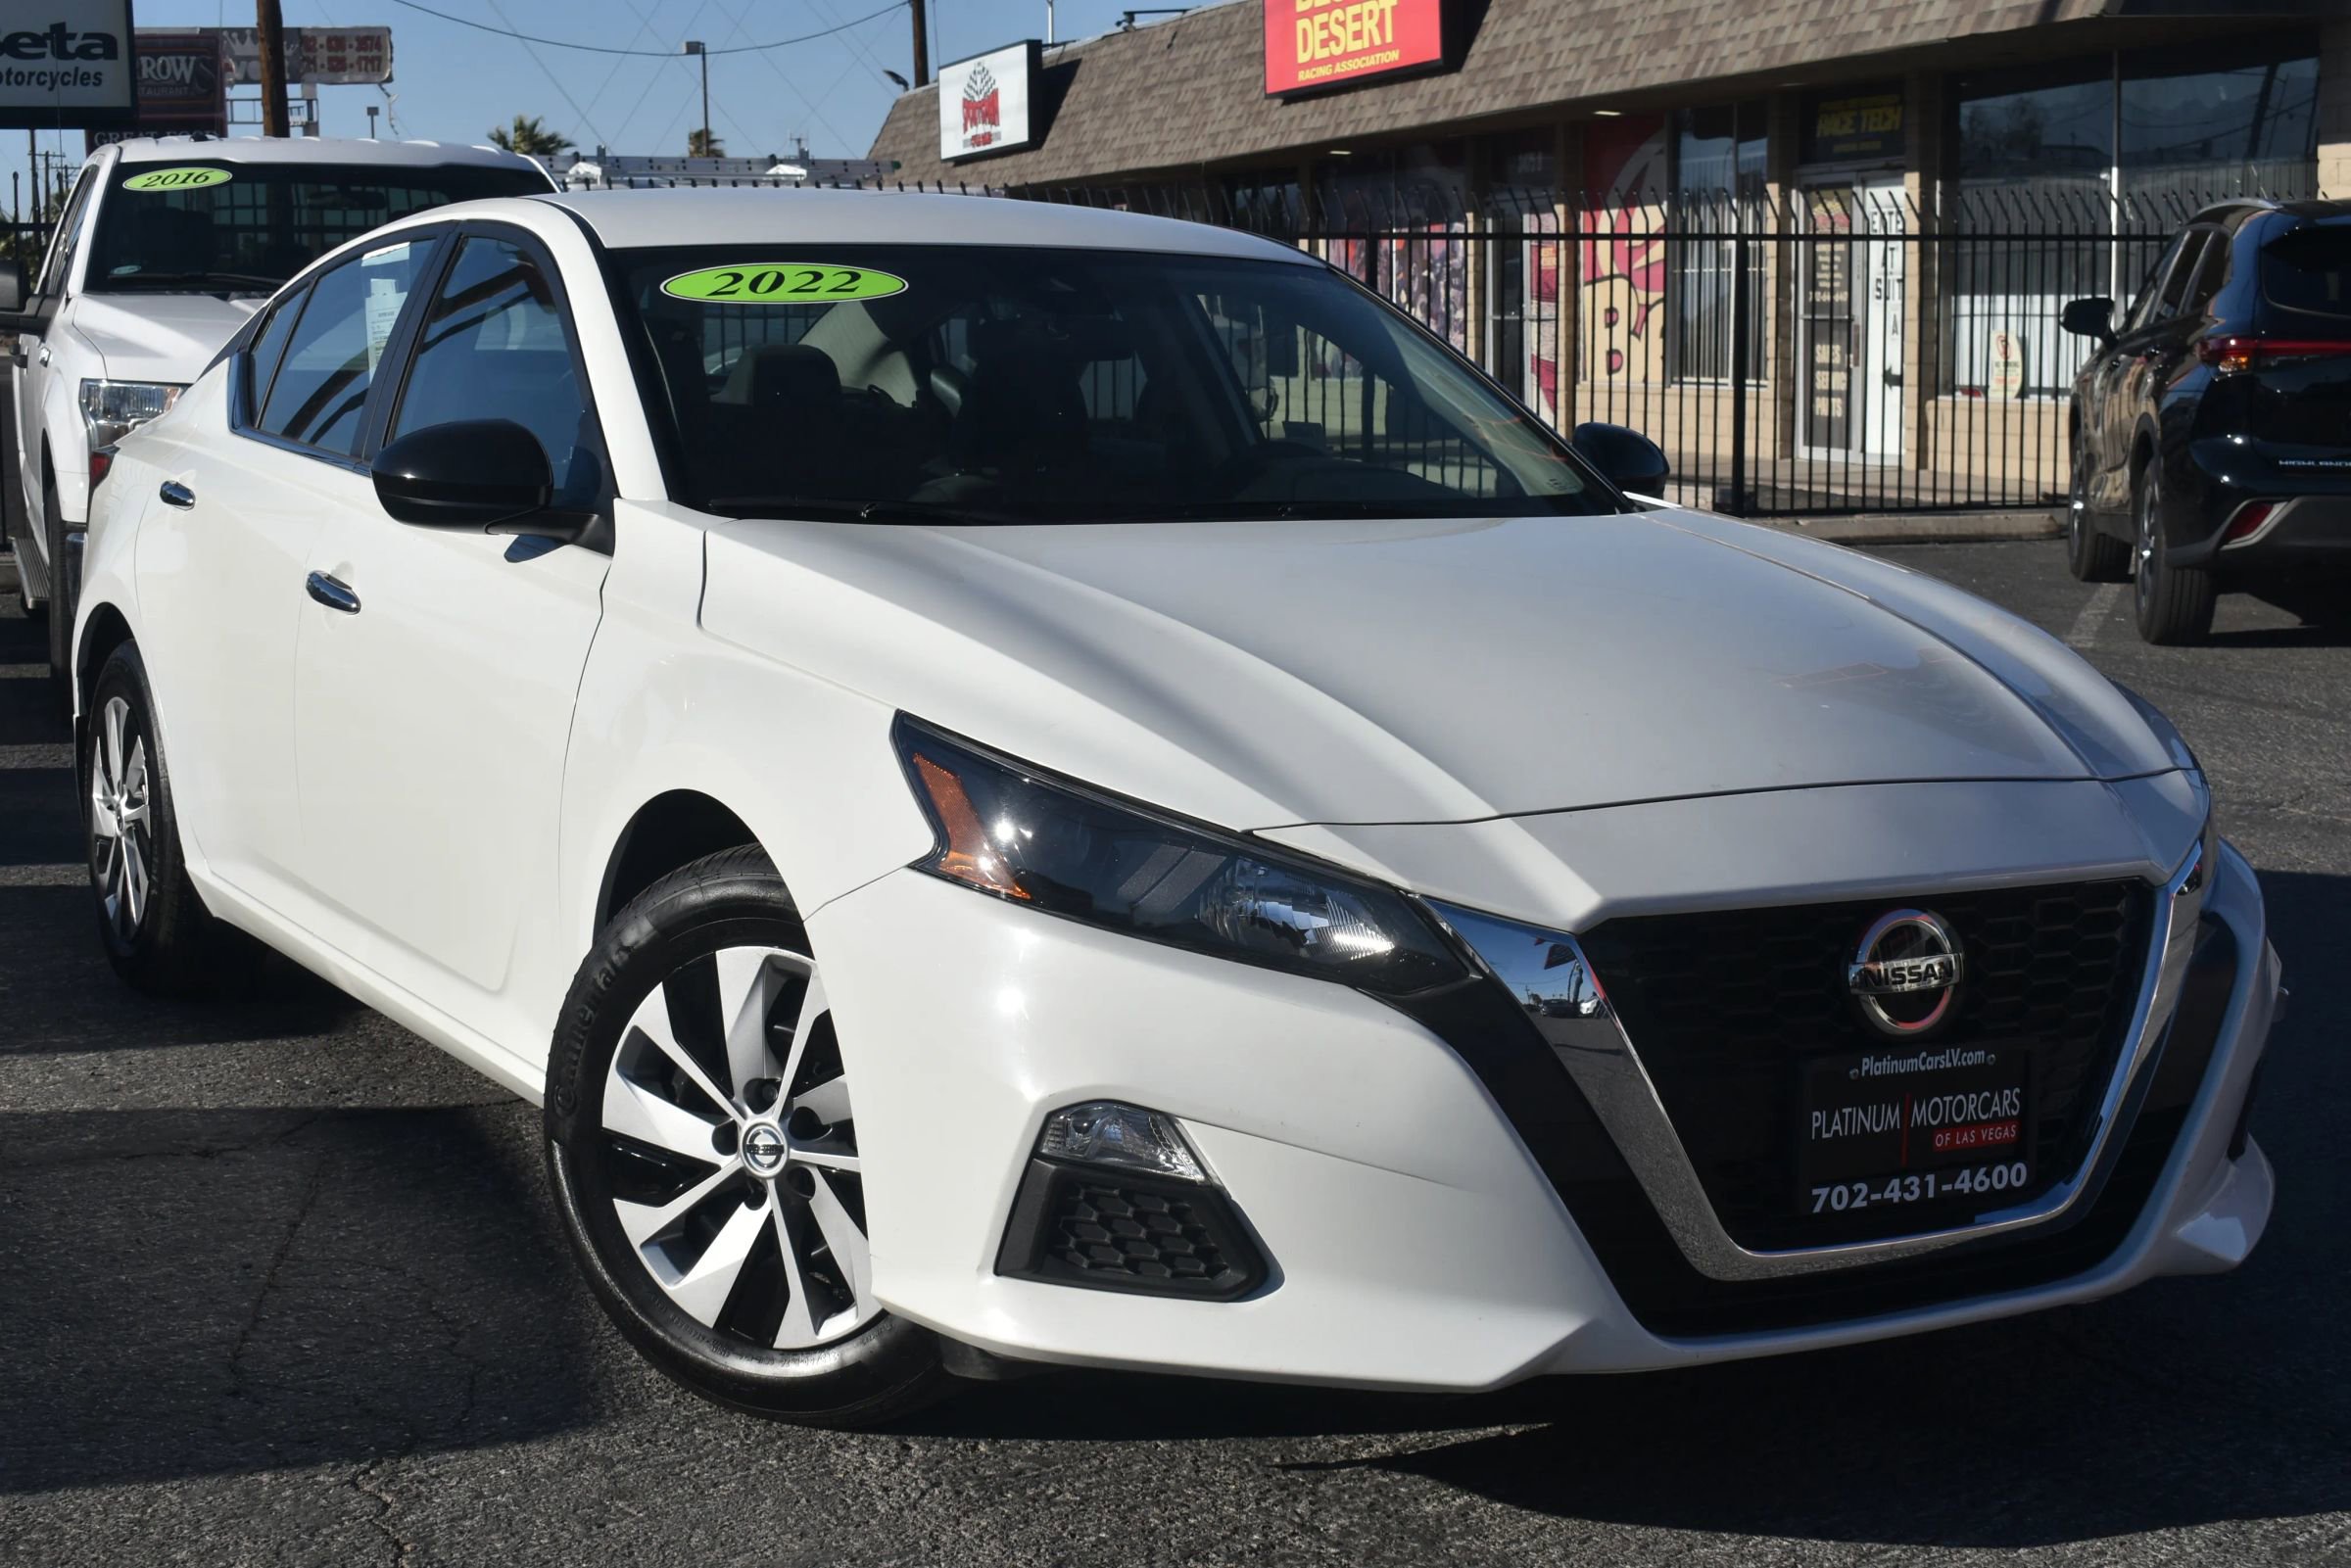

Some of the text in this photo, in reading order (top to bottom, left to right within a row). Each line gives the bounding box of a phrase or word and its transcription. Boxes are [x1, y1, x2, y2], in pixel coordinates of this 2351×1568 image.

[0, 22, 118, 60] eta
[1296, 0, 1398, 64] DESERT
[138, 55, 196, 84] ROW
[1298, 49, 1400, 81] RACING ASSOCIATION
[142, 170, 216, 188] 2016
[705, 270, 862, 297] 2022
[1862, 963, 1955, 986] NISSAN
[1861, 1047, 1986, 1077] PlatinumCarsLV.com
[1811, 1087, 2021, 1140] PLATINUM MOTORCARS
[1936, 1124, 2017, 1148] OF LAS VEGAS
[1812, 1162, 2028, 1213] 702-431-4600
